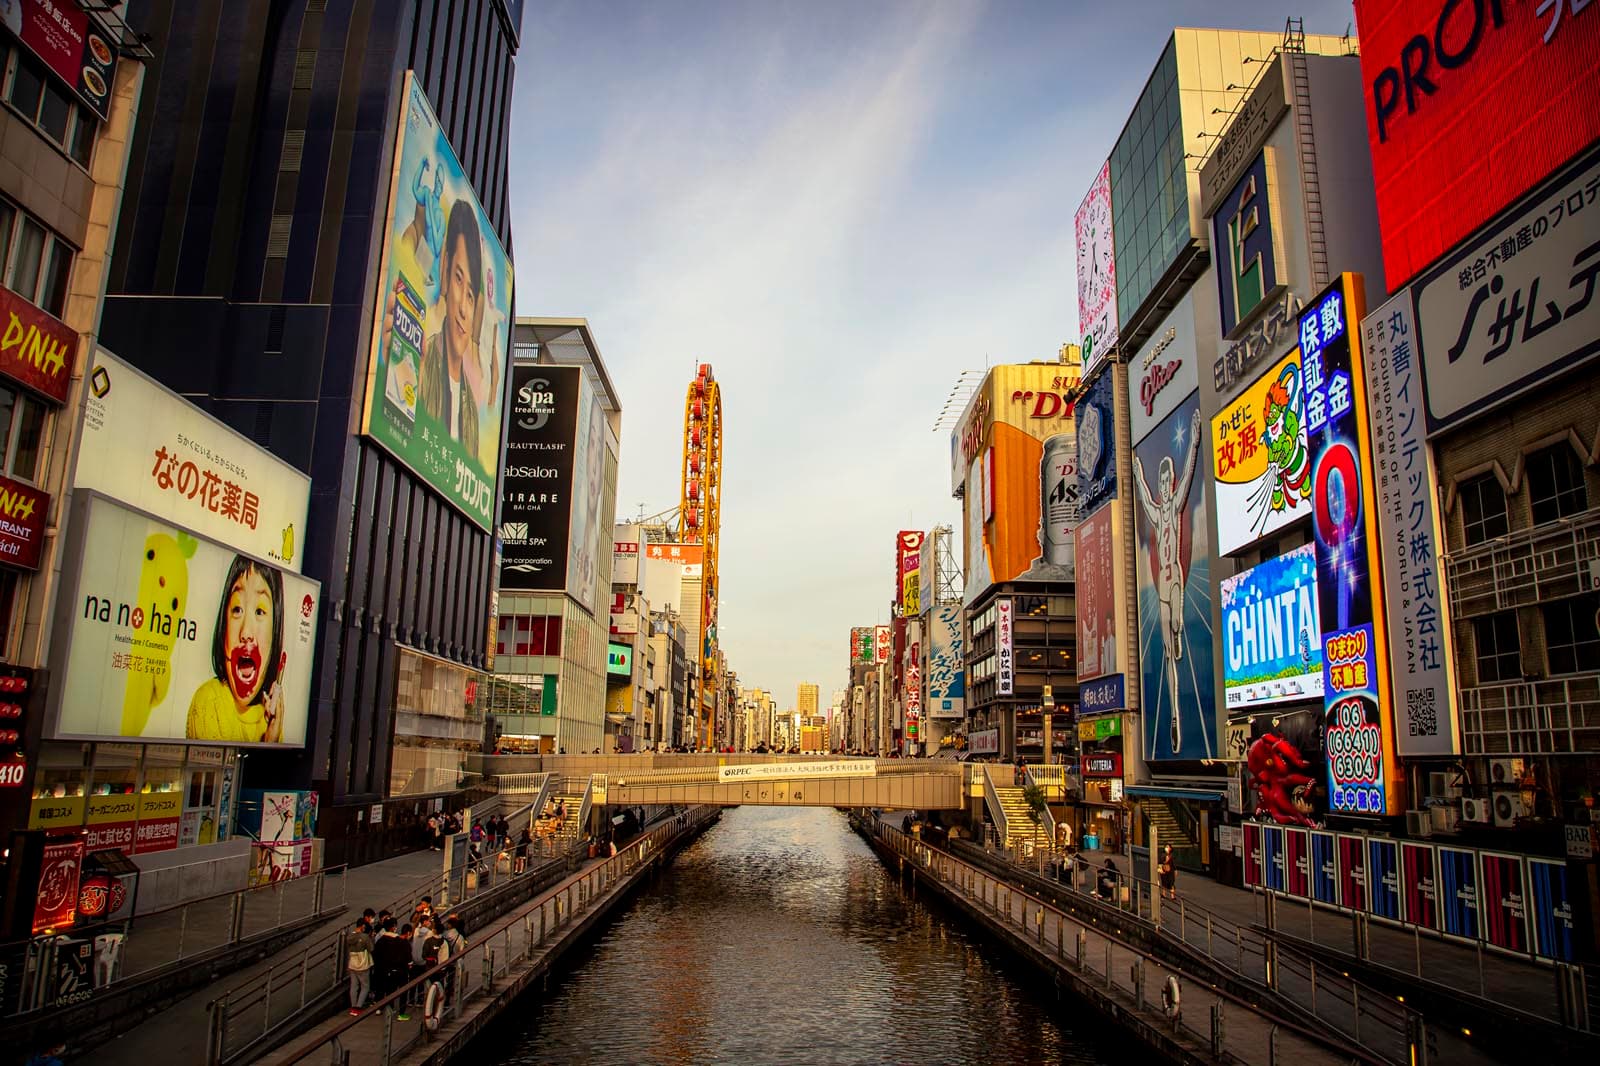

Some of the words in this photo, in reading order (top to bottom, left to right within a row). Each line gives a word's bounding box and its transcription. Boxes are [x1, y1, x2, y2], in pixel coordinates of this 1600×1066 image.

[1374, 0, 1504, 144] PRO
[1, 311, 68, 378] DINH
[1141, 359, 1182, 417] Glico
[1301, 319, 1327, 431] 保証金
[515, 406, 555, 414] treatment
[518, 386, 554, 408] Spa
[1220, 403, 1252, 441] かぜに
[1217, 420, 1258, 477] 改源
[151, 445, 260, 531] なの花薬局
[1387, 310, 1441, 672] 丸善インテック株式会社
[1380, 349, 1397, 455] FOUNDATION
[1396, 530, 1409, 592] WORLD
[1403, 616, 1416, 674] JAPAN
[112, 652, 143, 672] 油菜花
[1327, 630, 1367, 663] ひまわり
[1330, 661, 1368, 692] 不動産
[1341, 702, 1362, 730] 06
[1328, 726, 1379, 757] (6641)
[1091, 759, 1113, 771] LOTTERIA
[1335, 755, 1374, 781] 6304
[1333, 786, 1381, 812] 年中無休
